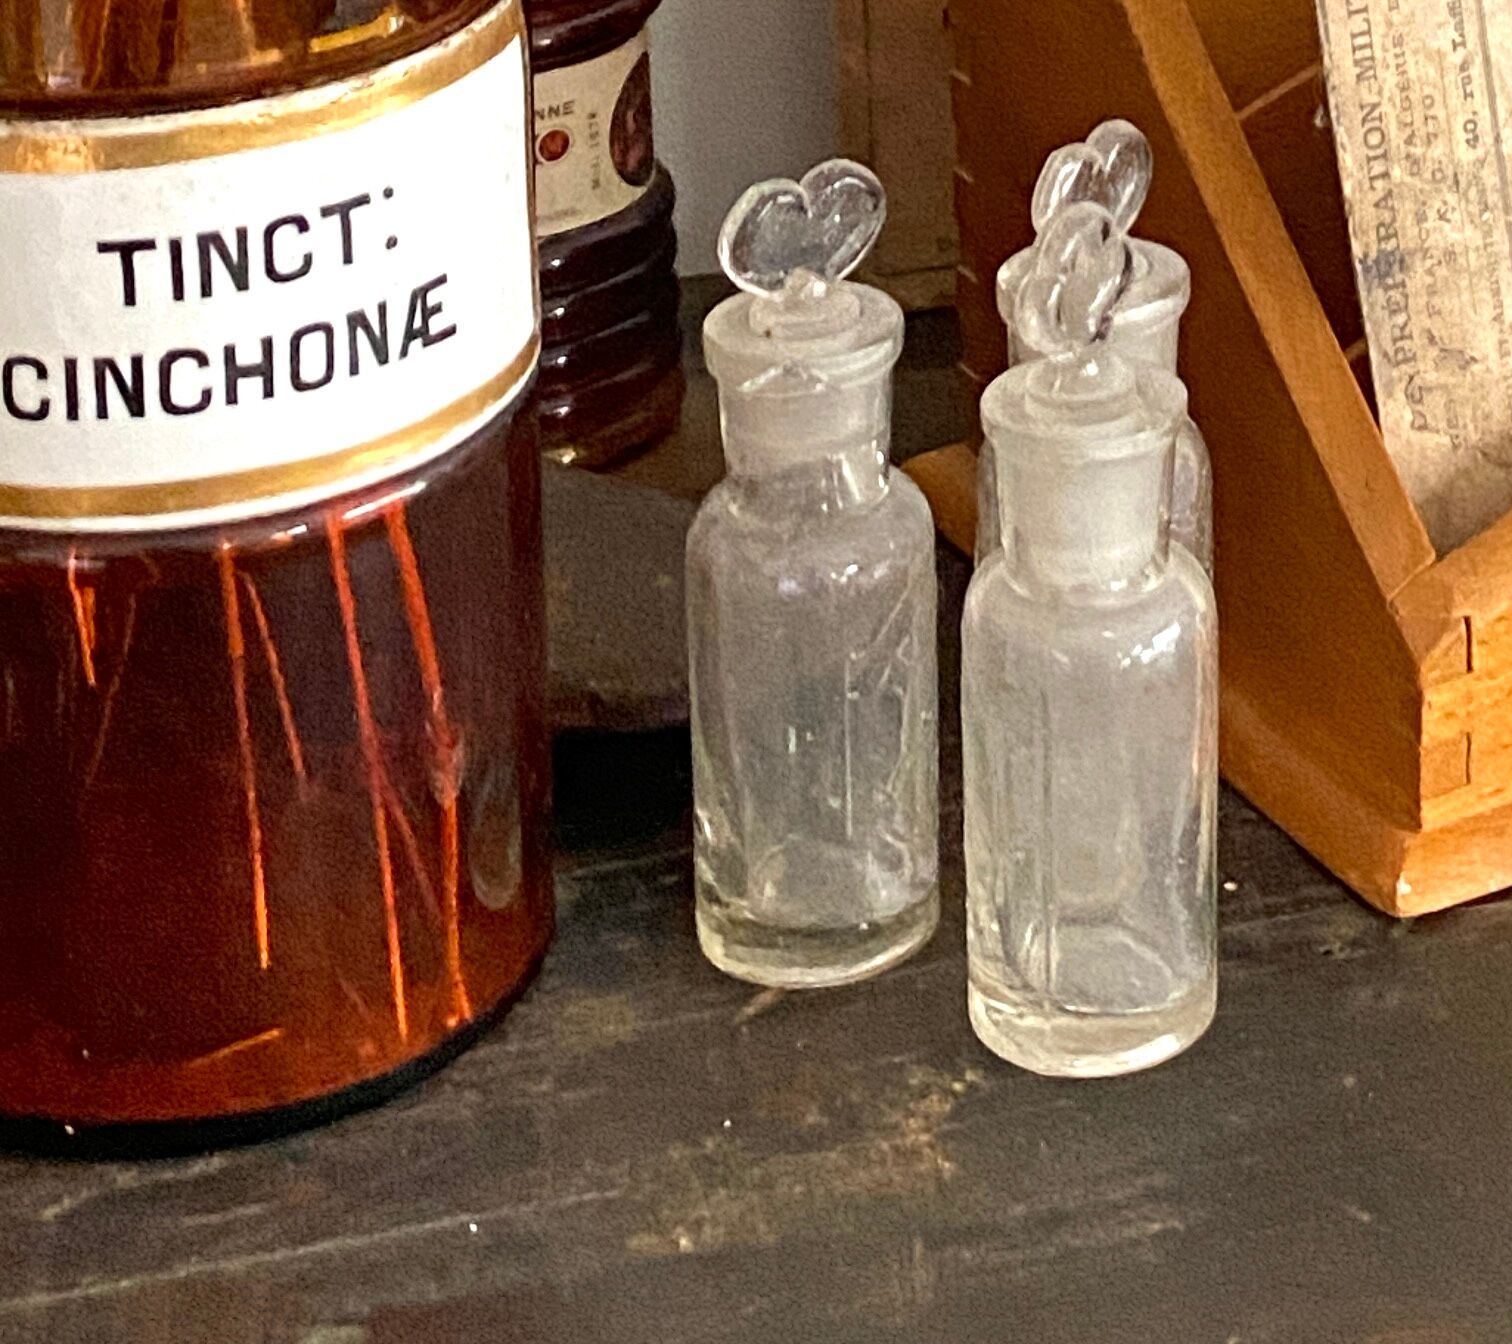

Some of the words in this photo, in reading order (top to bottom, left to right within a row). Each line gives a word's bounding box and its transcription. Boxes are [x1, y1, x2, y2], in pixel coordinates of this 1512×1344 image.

[1457, 61, 1475, 102] rue
[96, 185, 399, 308] TINCT:
[1, 272, 458, 422] CINCHONÆ
